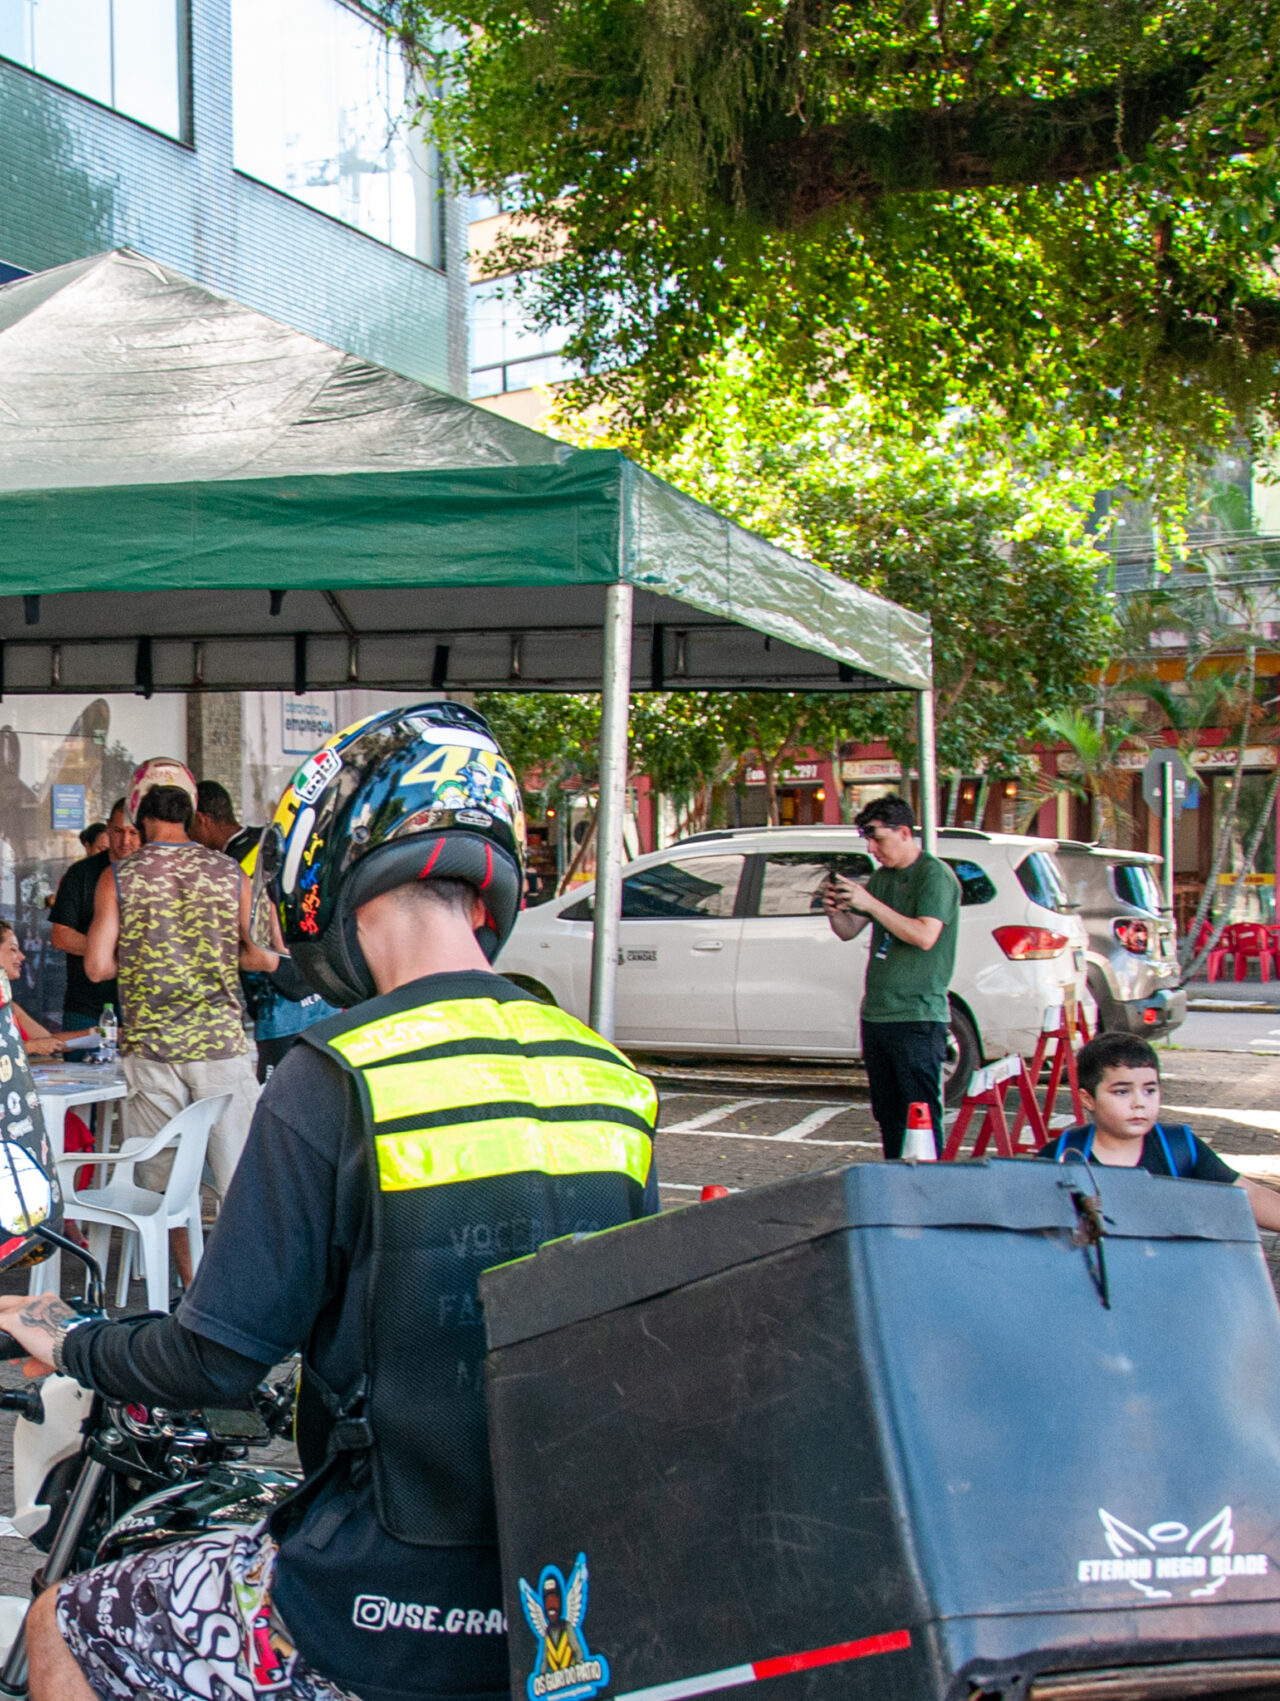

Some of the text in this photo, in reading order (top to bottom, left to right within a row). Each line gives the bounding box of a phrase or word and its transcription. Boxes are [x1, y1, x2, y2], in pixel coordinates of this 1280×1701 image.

[1078, 1558, 1153, 1583] ETERNO
[1210, 1554, 1268, 1577] BLADE
[533, 1674, 546, 1696] OS
